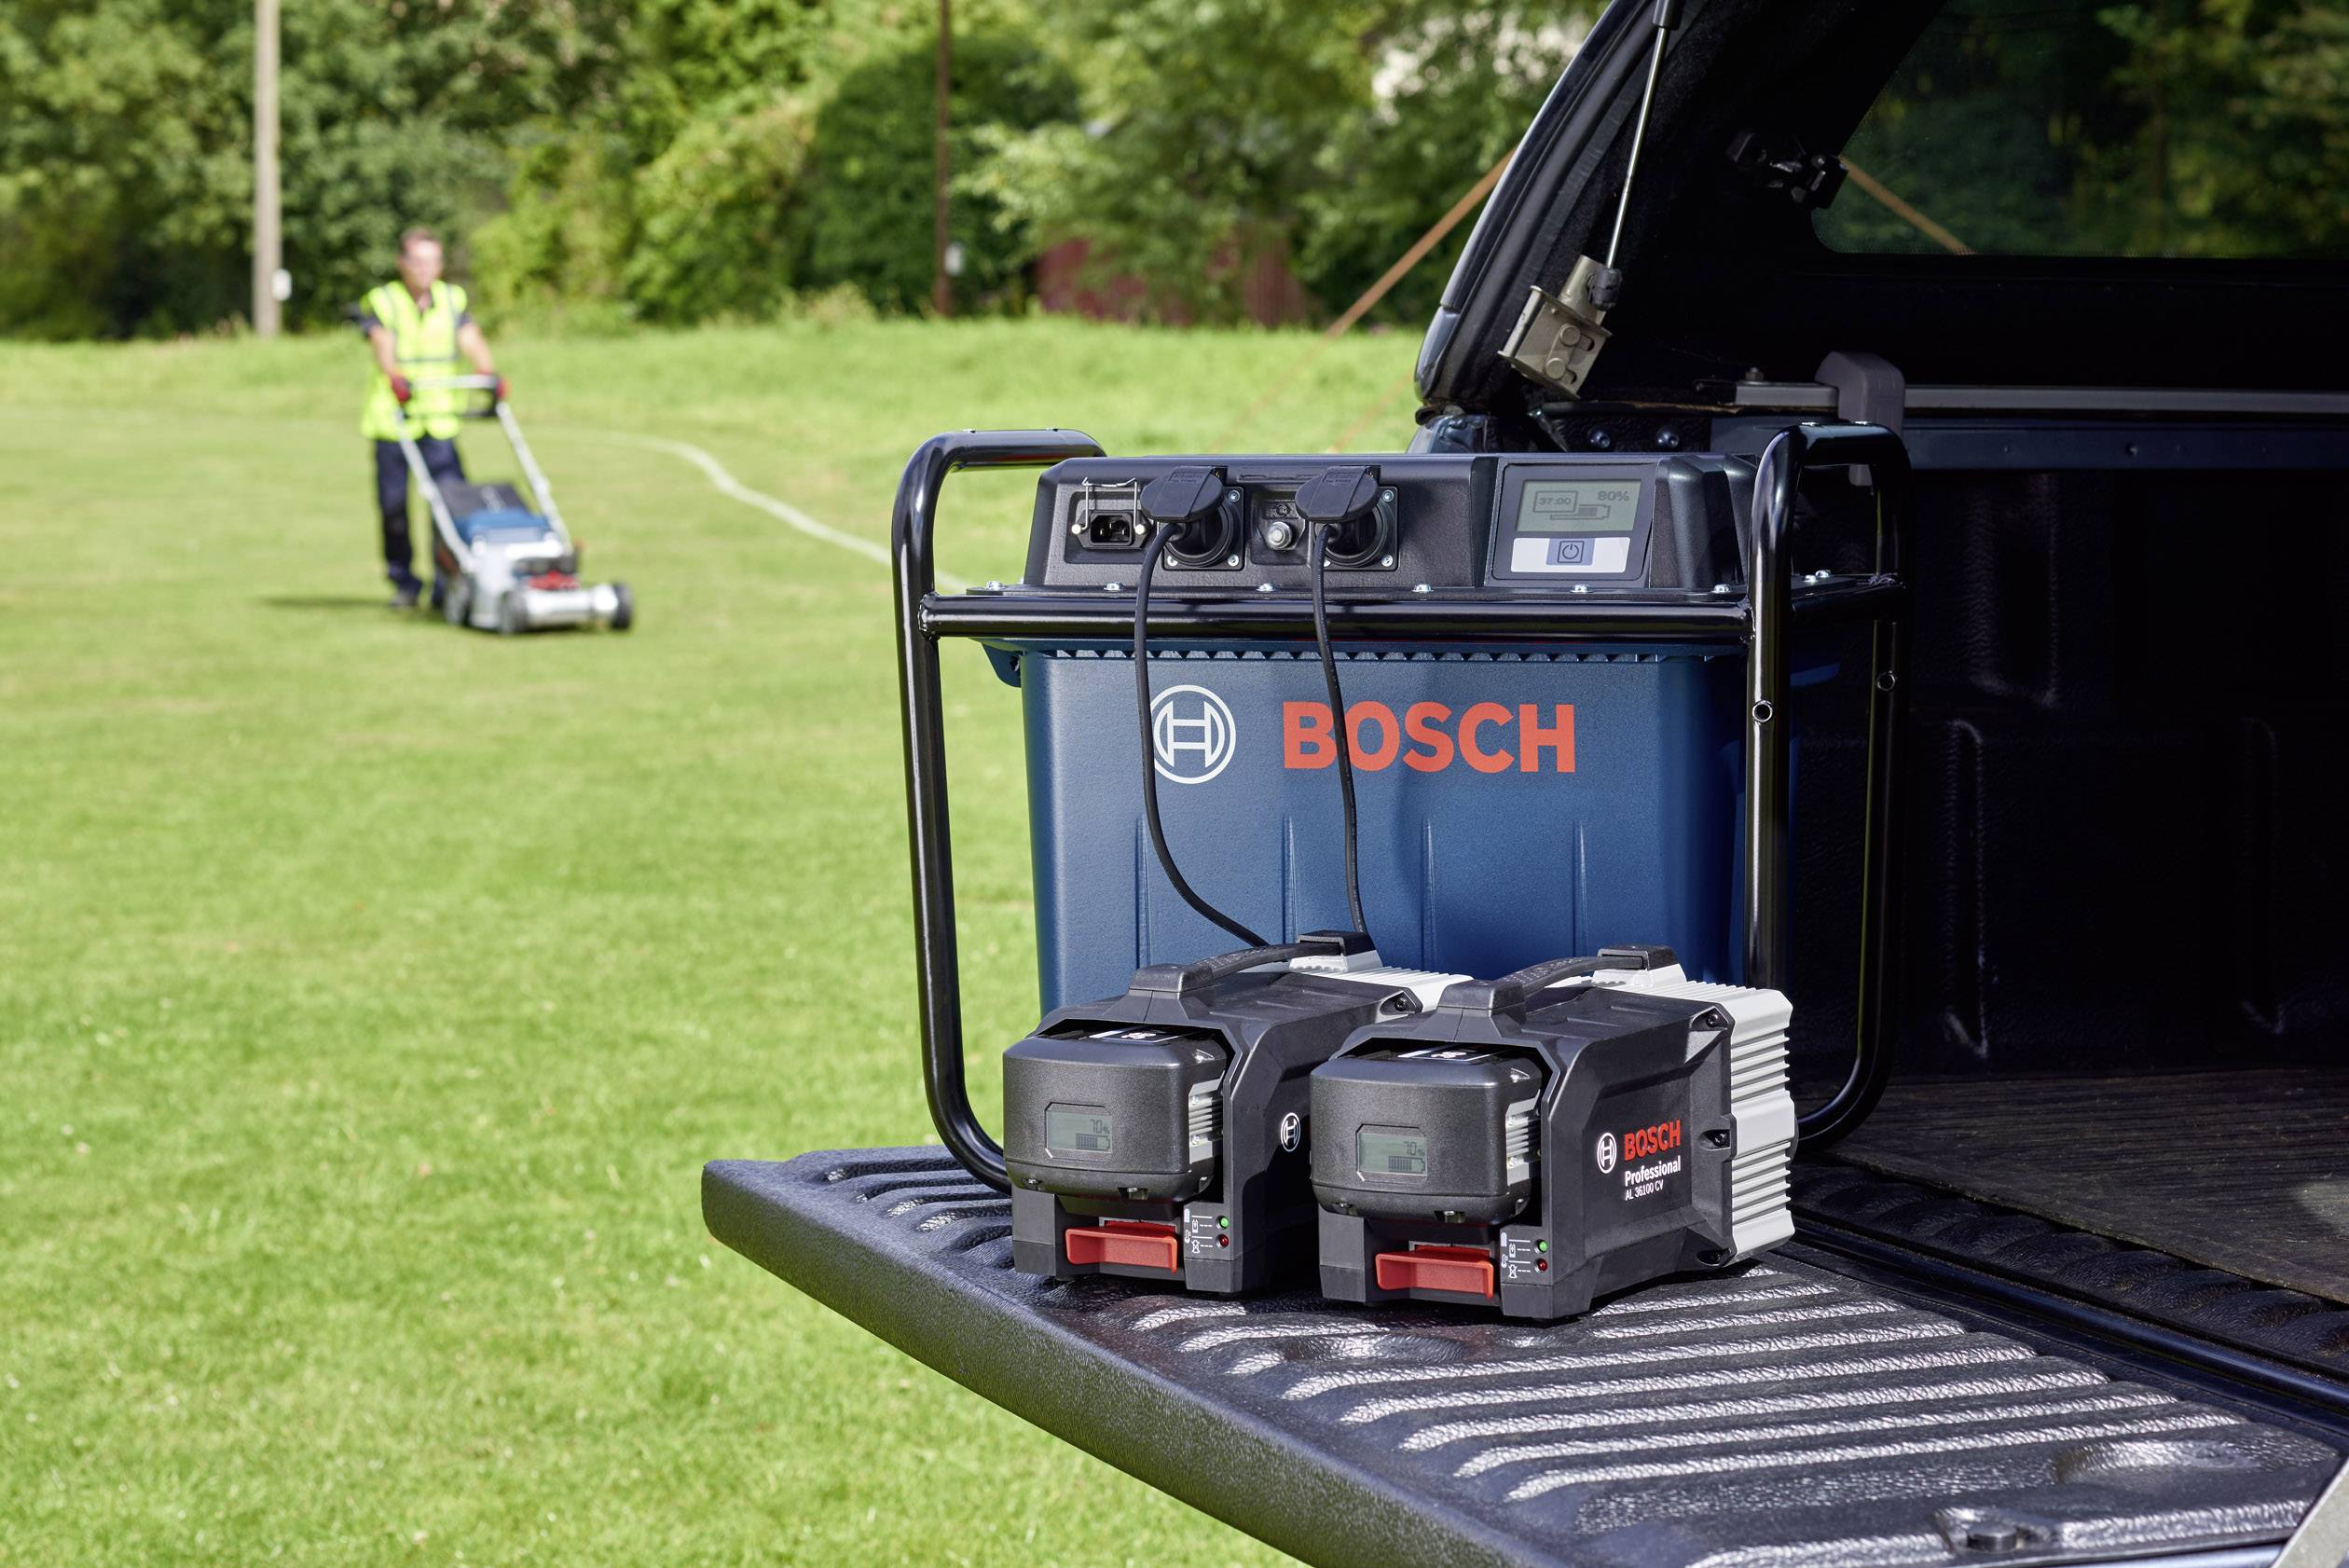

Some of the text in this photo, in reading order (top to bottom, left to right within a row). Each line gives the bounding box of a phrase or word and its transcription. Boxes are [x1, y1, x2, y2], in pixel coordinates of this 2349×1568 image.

[1538, 496, 1572, 505] 37:00
[1598, 490, 1630, 502] 80%
[1283, 700, 1575, 773] BOSCH
[1090, 1119, 1110, 1135] 70%
[1403, 1140, 1425, 1156] 70%
[1625, 1119, 1681, 1162] BOSCH
[1625, 1155, 1682, 1187] Professional
[1625, 1178, 1664, 1201] AL 36100 CV
